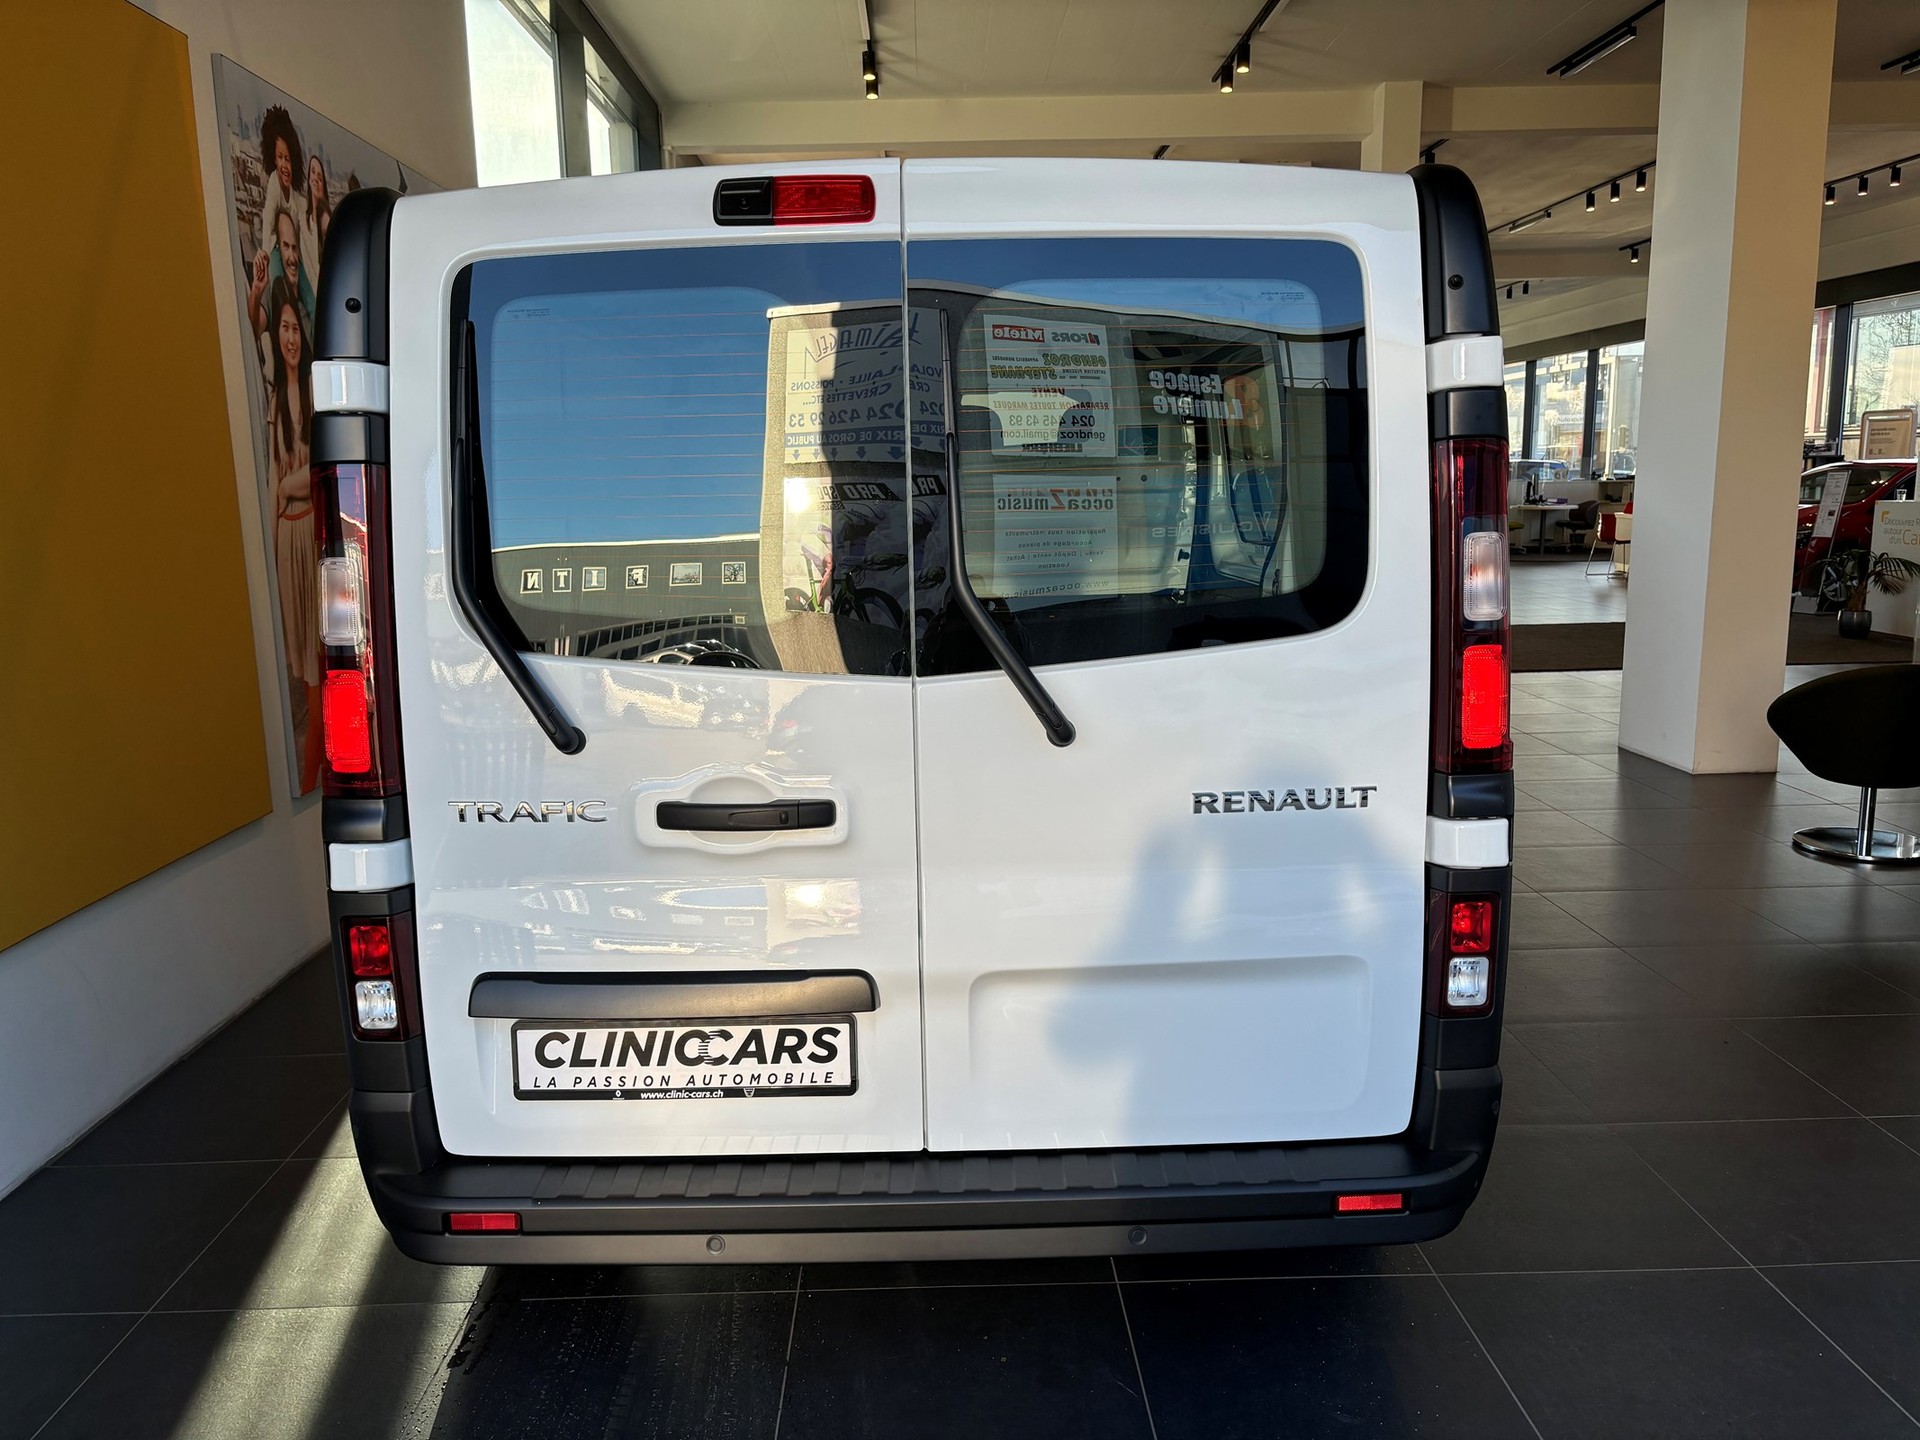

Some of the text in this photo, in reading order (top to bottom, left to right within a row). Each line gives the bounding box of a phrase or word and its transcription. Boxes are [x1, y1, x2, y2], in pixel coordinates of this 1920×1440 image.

[1192, 786, 1377, 814] RENAULT
[448, 800, 608, 823] TRAFIC
[534, 1071, 835, 1088] LA PASSION AUTOMOBILE
[640, 1089, 724, 1099] www.clinic-cars.ch
